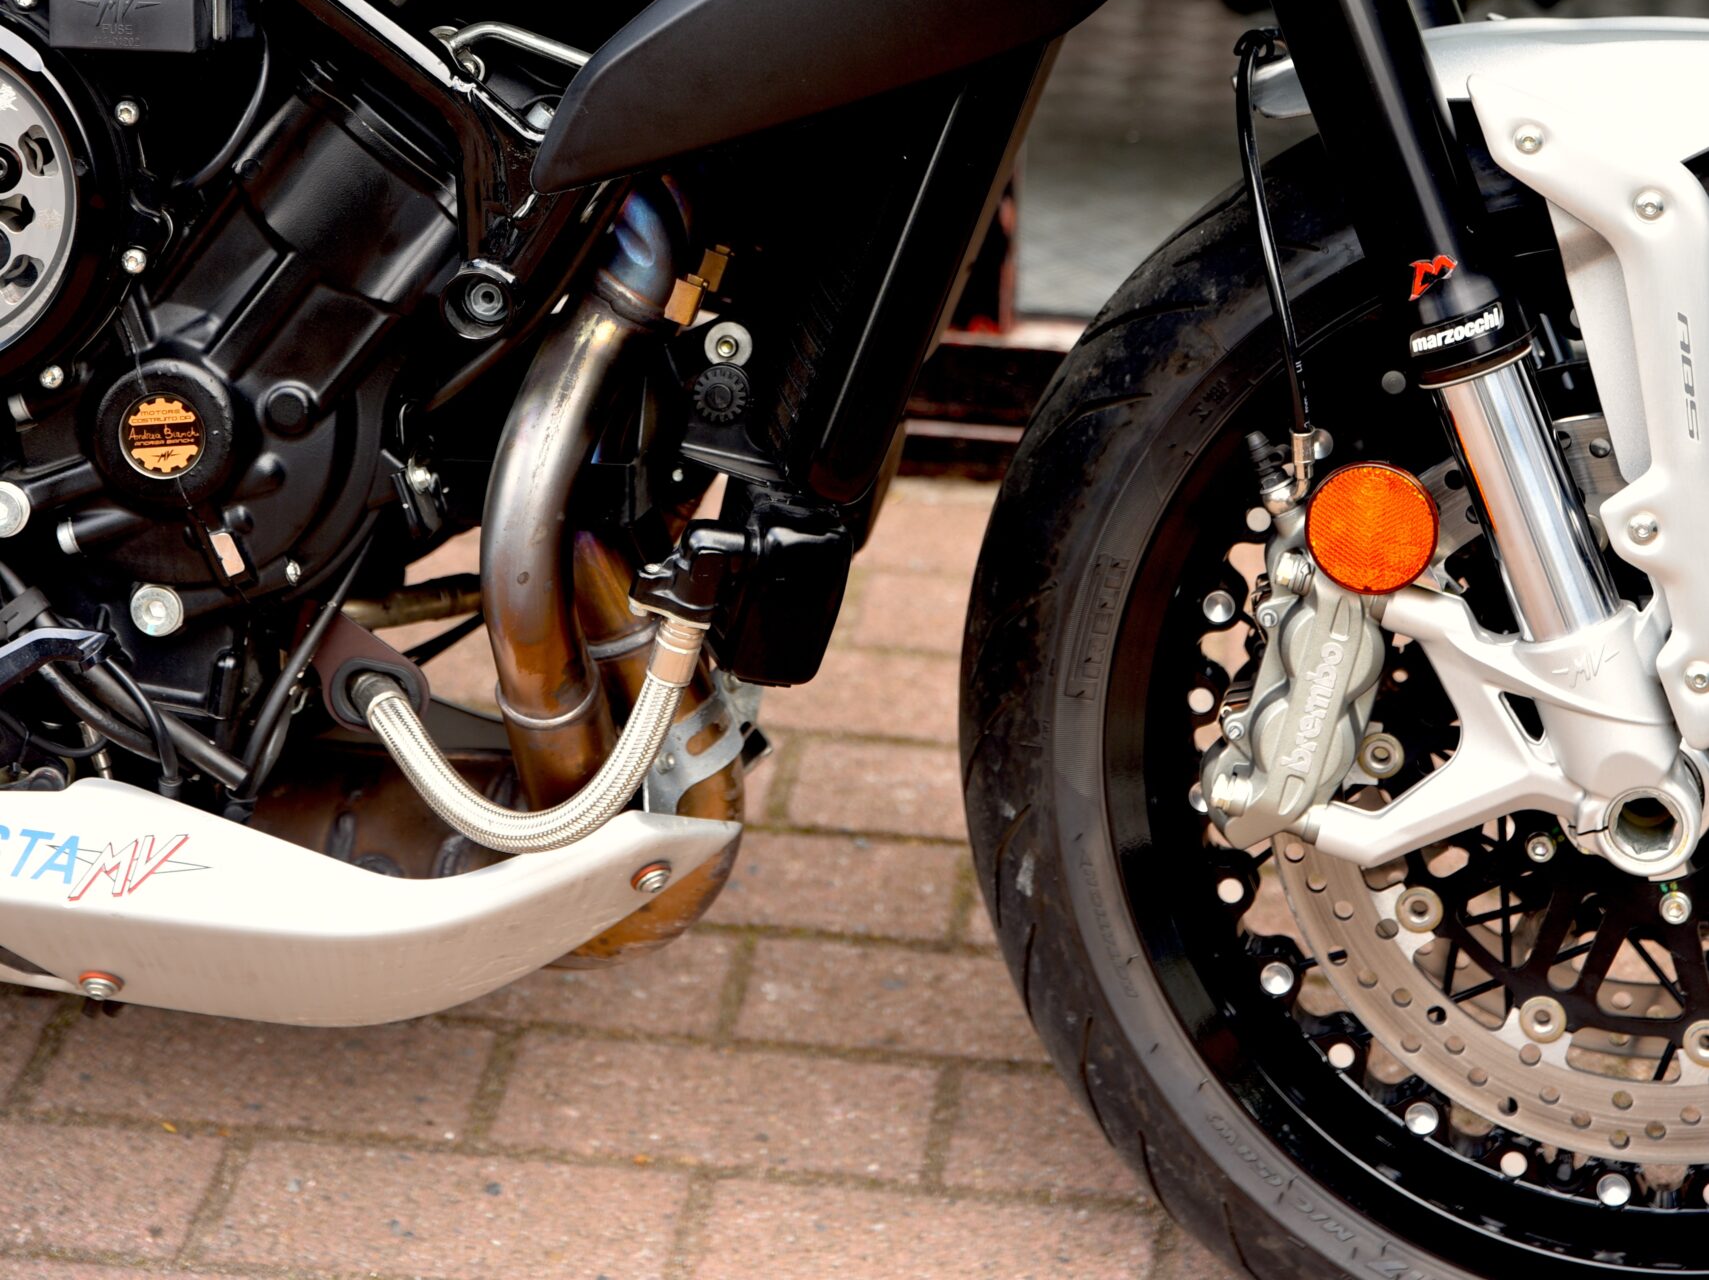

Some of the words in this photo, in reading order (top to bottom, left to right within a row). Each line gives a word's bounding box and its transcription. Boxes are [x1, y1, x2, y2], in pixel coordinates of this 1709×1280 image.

[101, 23, 133, 35] FUSE
[1411, 307, 1500, 353] marzocchi
[1280, 641, 1345, 774] brembo
[0, 824, 79, 885] TA
